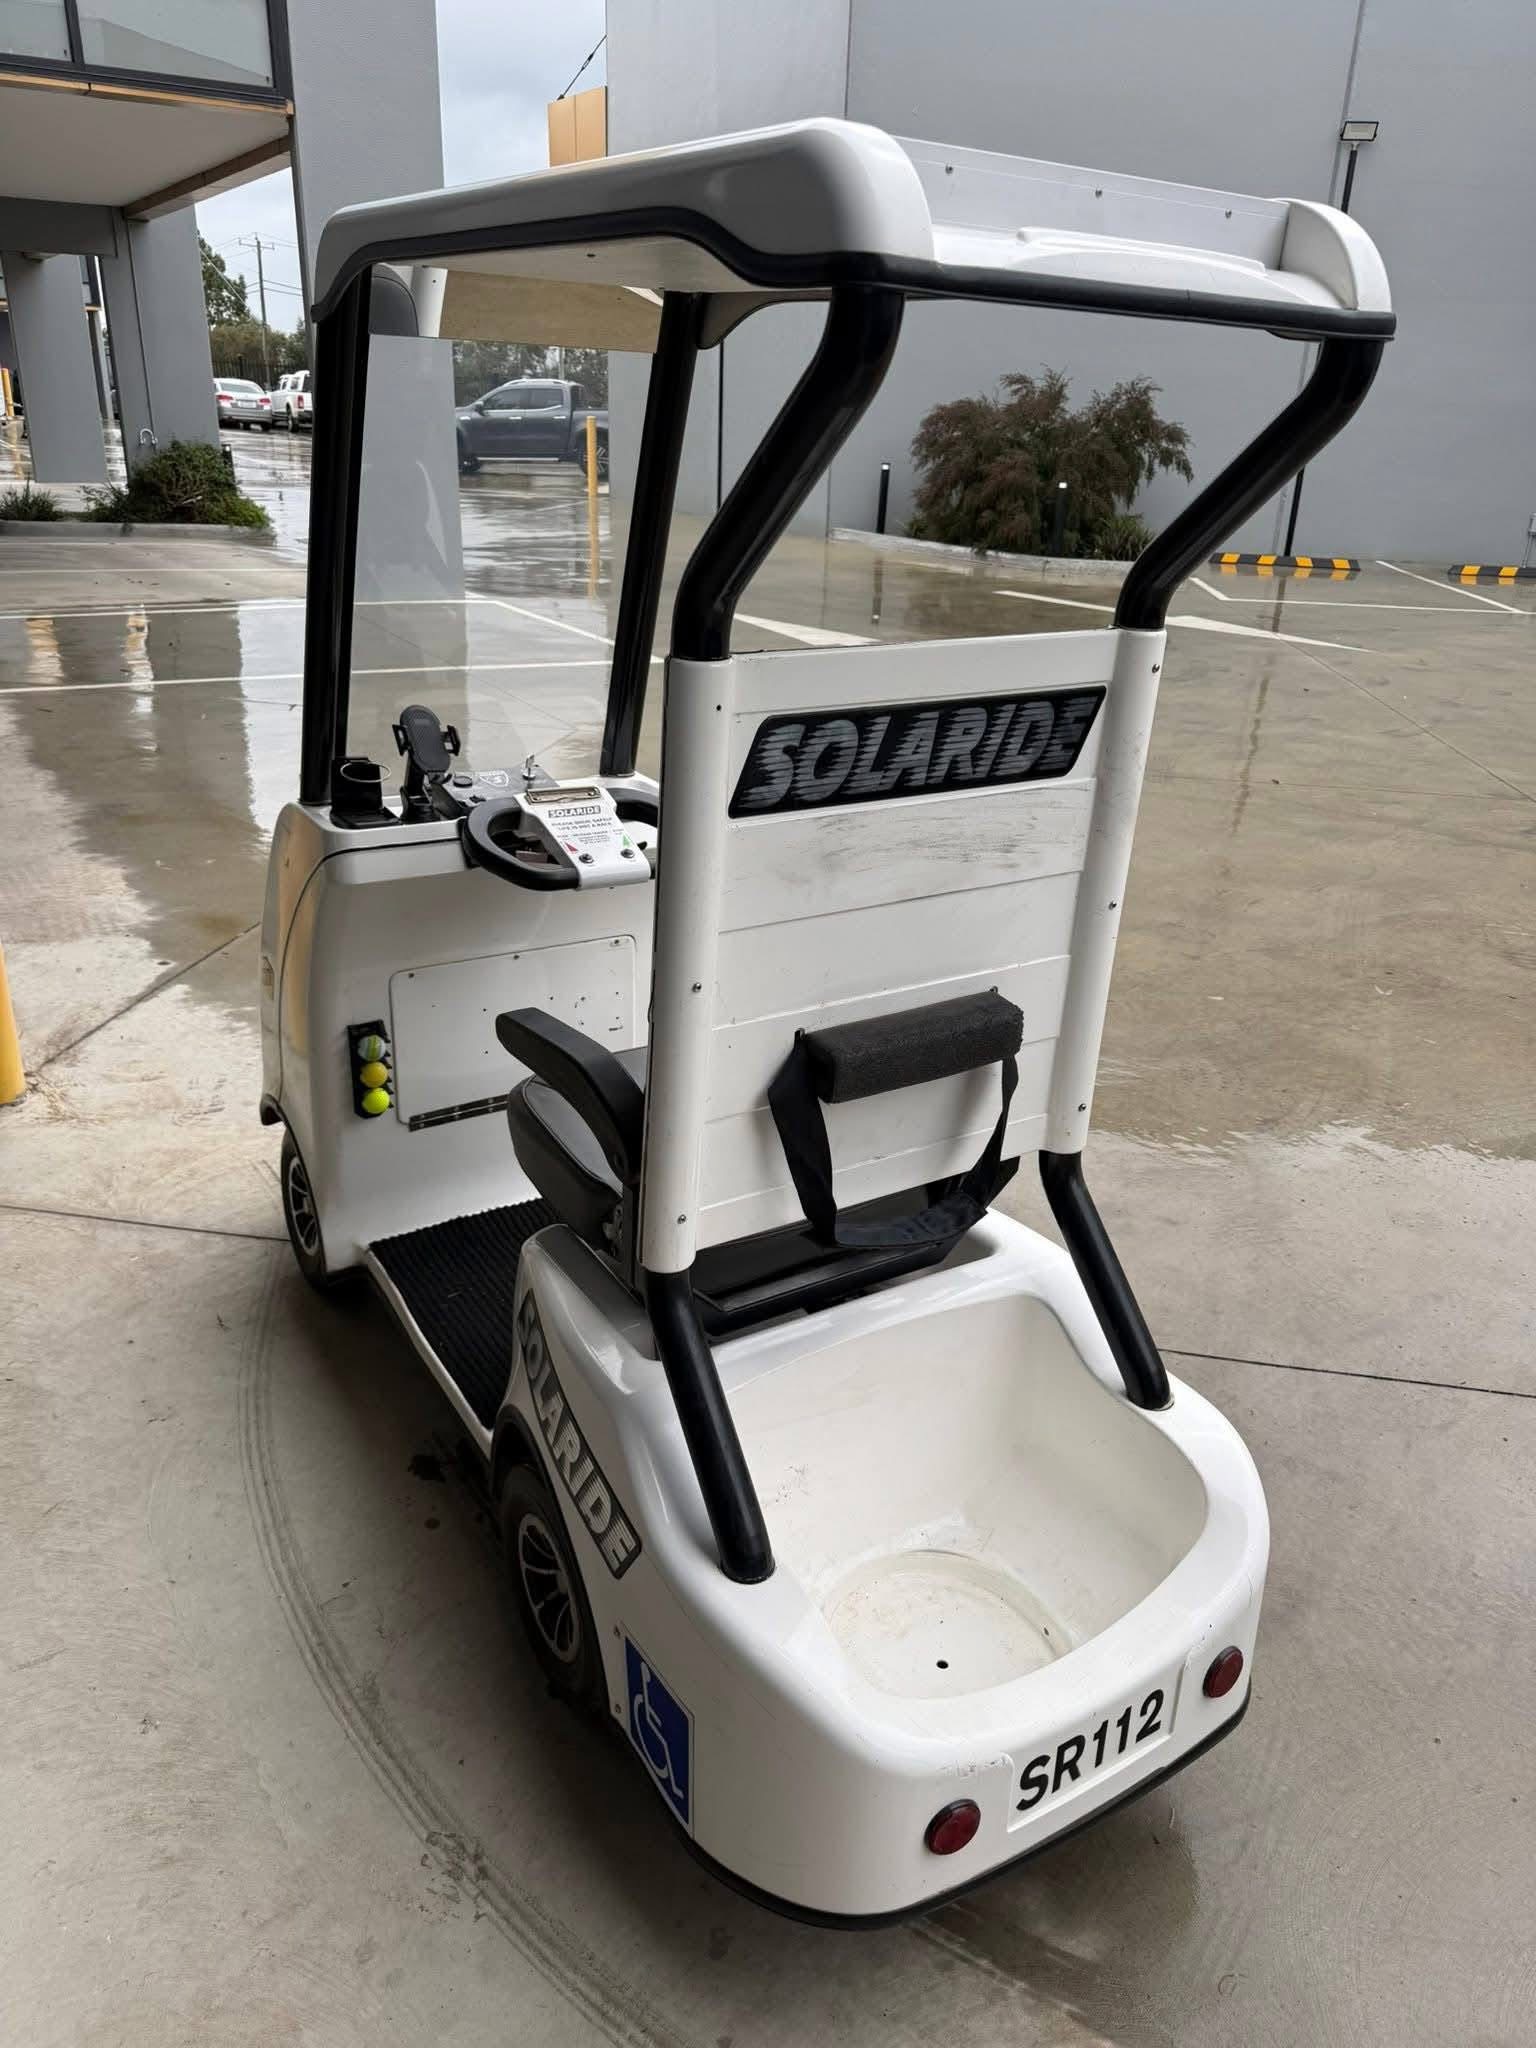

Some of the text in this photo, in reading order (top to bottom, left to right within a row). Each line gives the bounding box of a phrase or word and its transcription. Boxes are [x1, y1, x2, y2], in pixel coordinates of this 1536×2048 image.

[740, 695, 1099, 808] SOLARIDE
[549, 806, 600, 818] SOLARIDE
[1016, 1689, 1164, 1811] SR112
